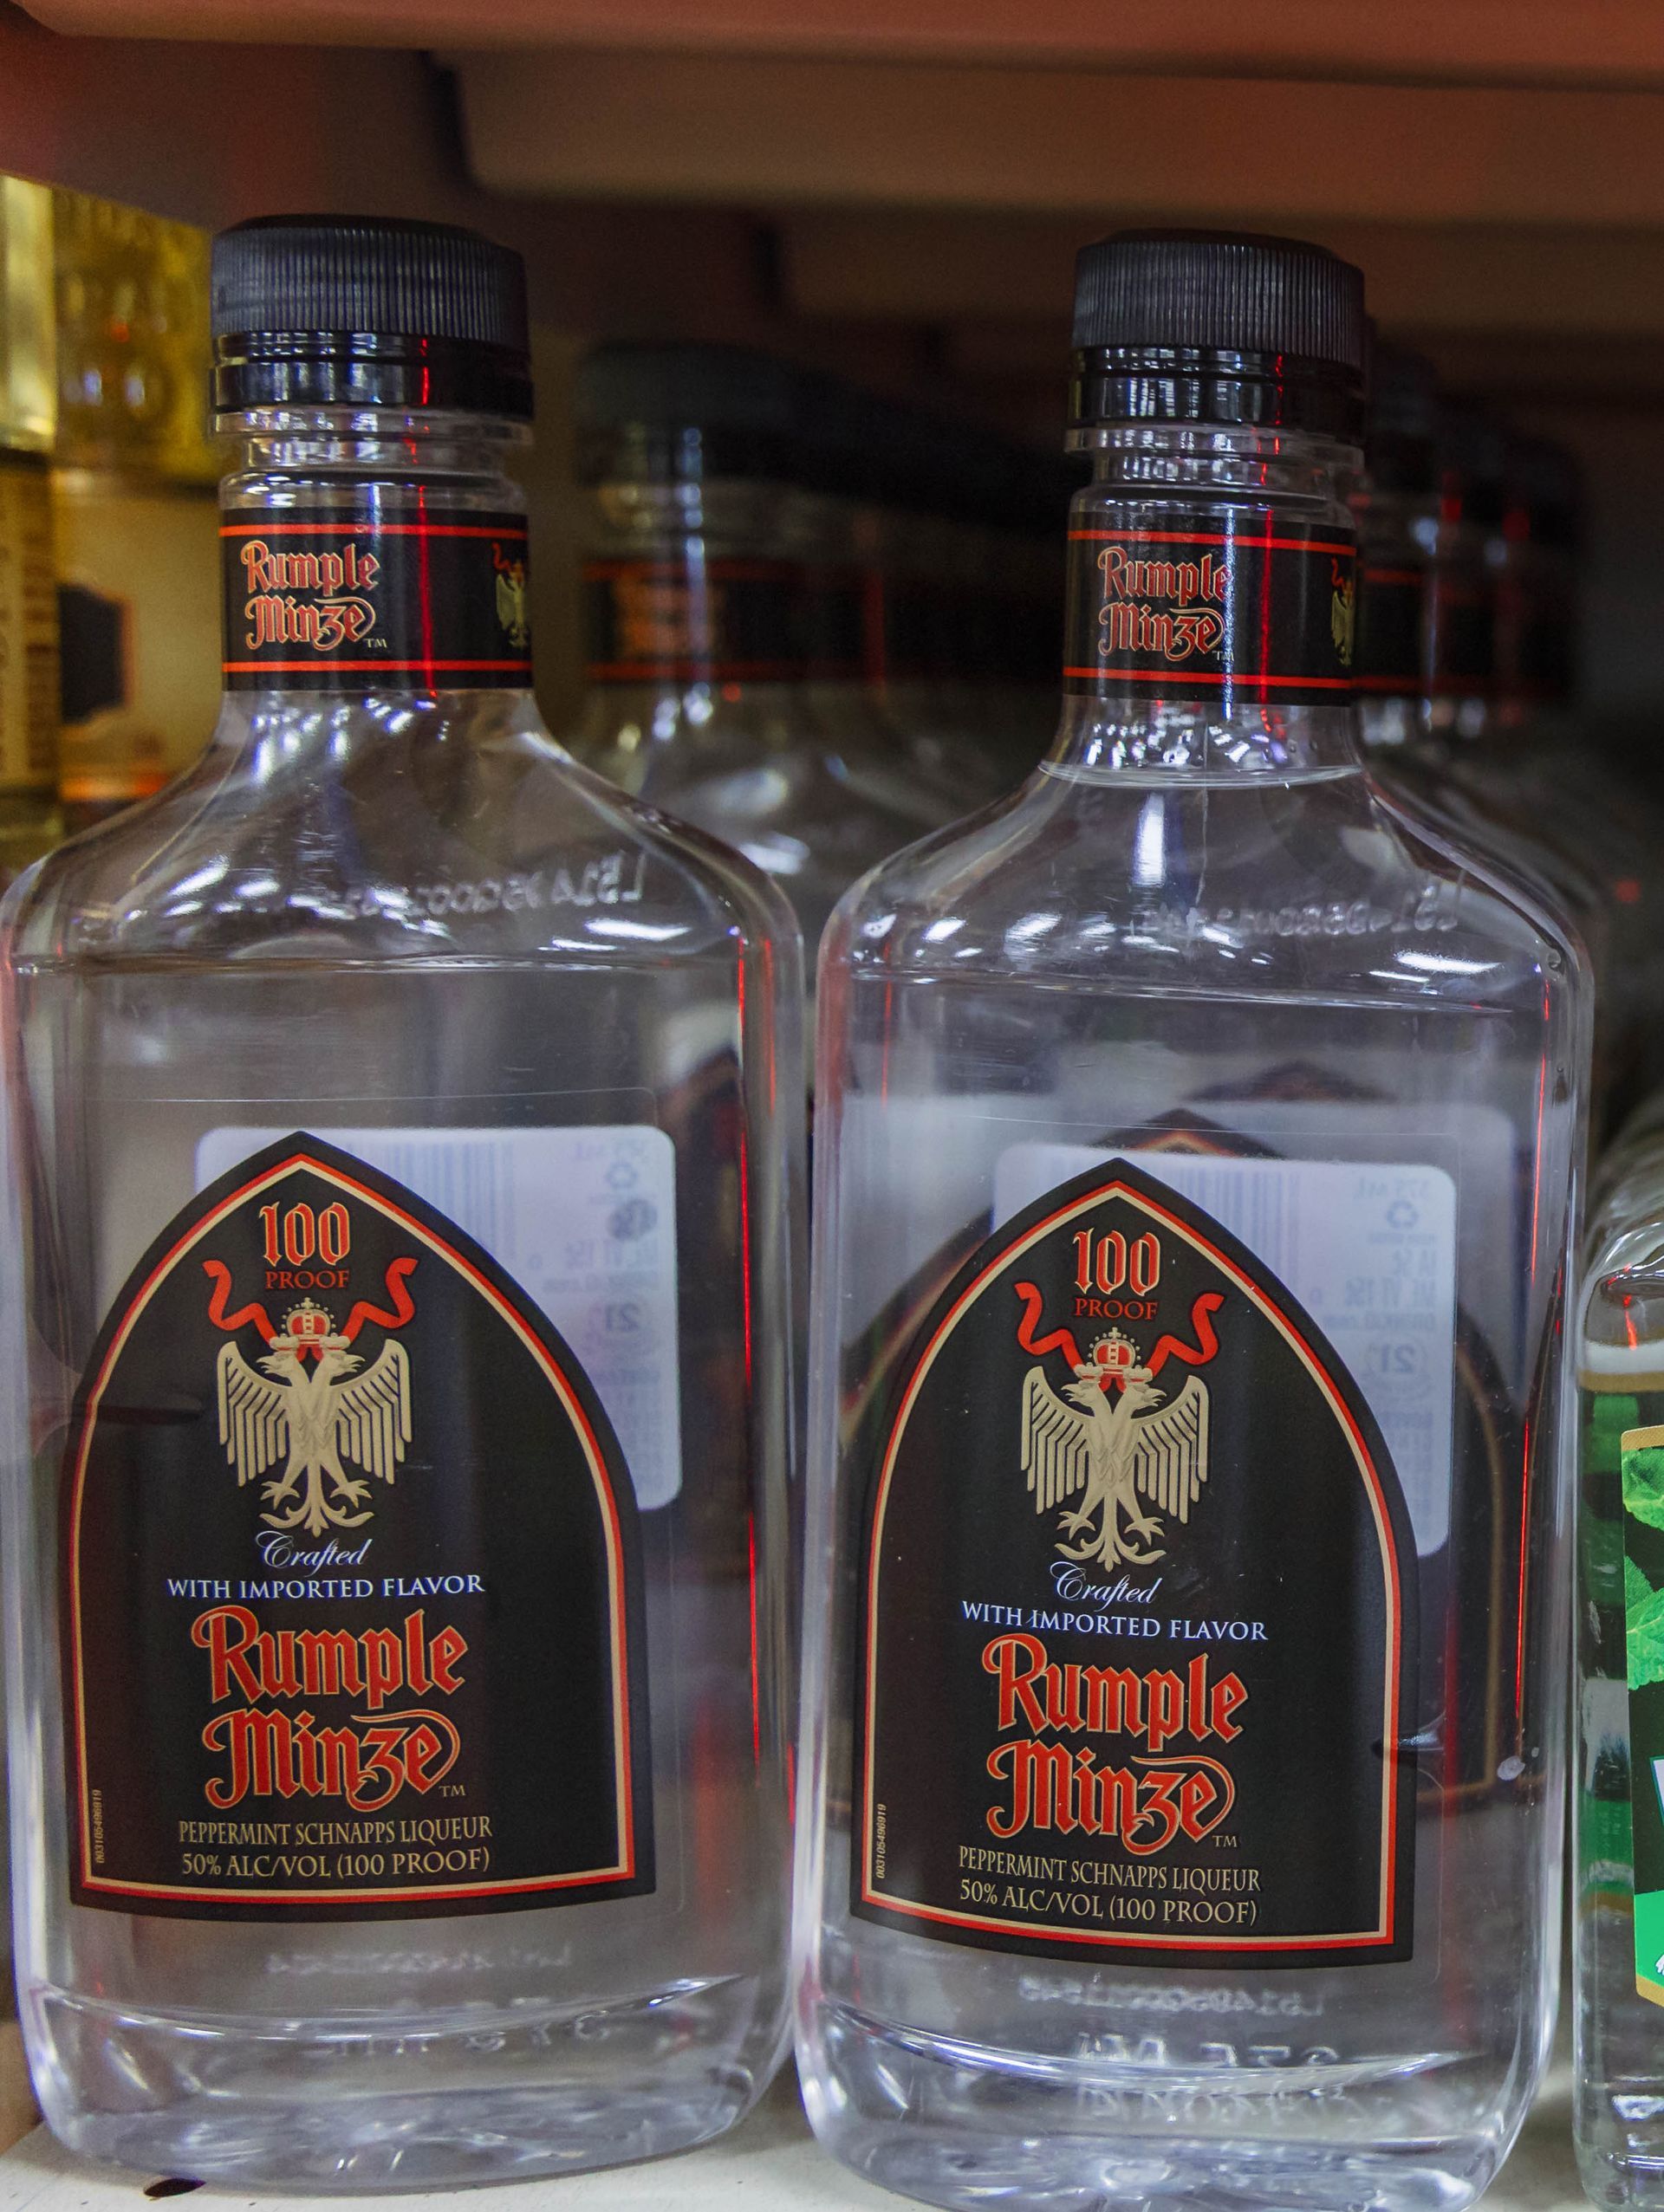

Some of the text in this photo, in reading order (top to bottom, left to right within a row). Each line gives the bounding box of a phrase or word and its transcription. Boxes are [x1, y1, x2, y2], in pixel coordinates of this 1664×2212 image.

[241, 540, 380, 597] Rumple
[1097, 546, 1233, 607] Rumple
[244, 595, 376, 651] Minze
[363, 638, 387, 649] TM
[1098, 602, 1225, 661] Minze
[259, 1201, 350, 1267] 100
[264, 1270, 350, 1289] PROOF
[1072, 1227, 1160, 1297] 100
[1075, 1298, 1159, 1320] PROOF
[255, 1530, 373, 1578] Crafted
[166, 1574, 486, 1599] WITH IMPORTED FLAVOR
[1050, 1561, 1163, 1612] Crafted
[961, 1600, 1269, 1642] WITH IMPORTED FLAVOR
[191, 1605, 468, 1710] Rumple
[982, 1632, 1248, 1753] Rumple
[202, 1709, 461, 1813] Minze
[439, 1784, 466, 1798] TM
[986, 1739, 1235, 1856] Minze
[179, 1816, 493, 1846] PEPPERMINT SCHNAPPS LIQUEUR
[1212, 1835, 1238, 1848] TM
[182, 1846, 490, 1879] 50% ALC/VOL (100 PROOF)
[959, 1845, 1261, 1895] PEPPERMINT SCHNAPPS LIQUEUR
[959, 1878, 1258, 1926] 50% ALC/VOL (100 PROOF)
